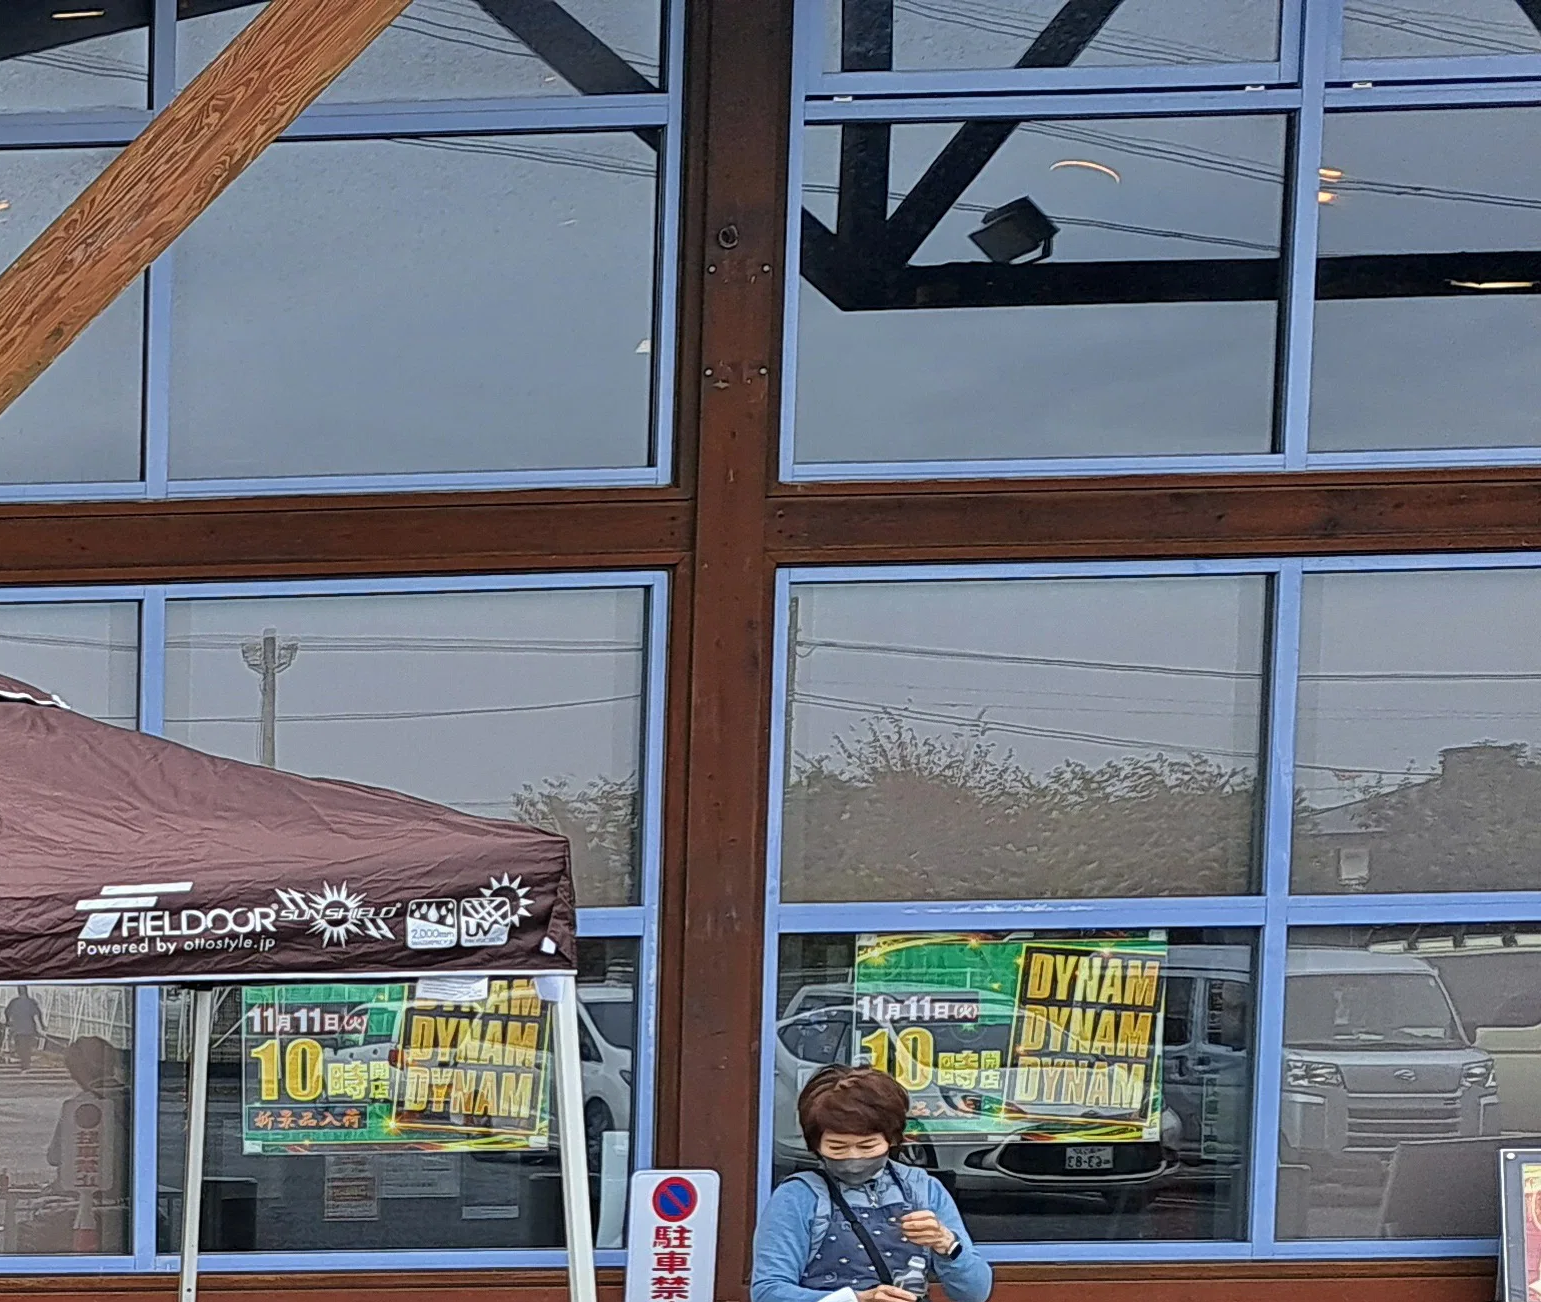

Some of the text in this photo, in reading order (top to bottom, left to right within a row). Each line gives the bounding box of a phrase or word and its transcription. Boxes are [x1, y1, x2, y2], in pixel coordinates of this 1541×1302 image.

[121, 907, 277, 937] FIELDOOR
[278, 909, 321, 921] SUN
[77, 933, 276, 957] Powered by ottostyle.jp
[1026, 952, 1161, 1007] DYNAM
[410, 1015, 540, 1068] DYNAM
[1020, 1004, 1154, 1058] DYNAM
[403, 1066, 534, 1119] DYNAM
[1015, 1055, 1147, 1110] DYNAM
